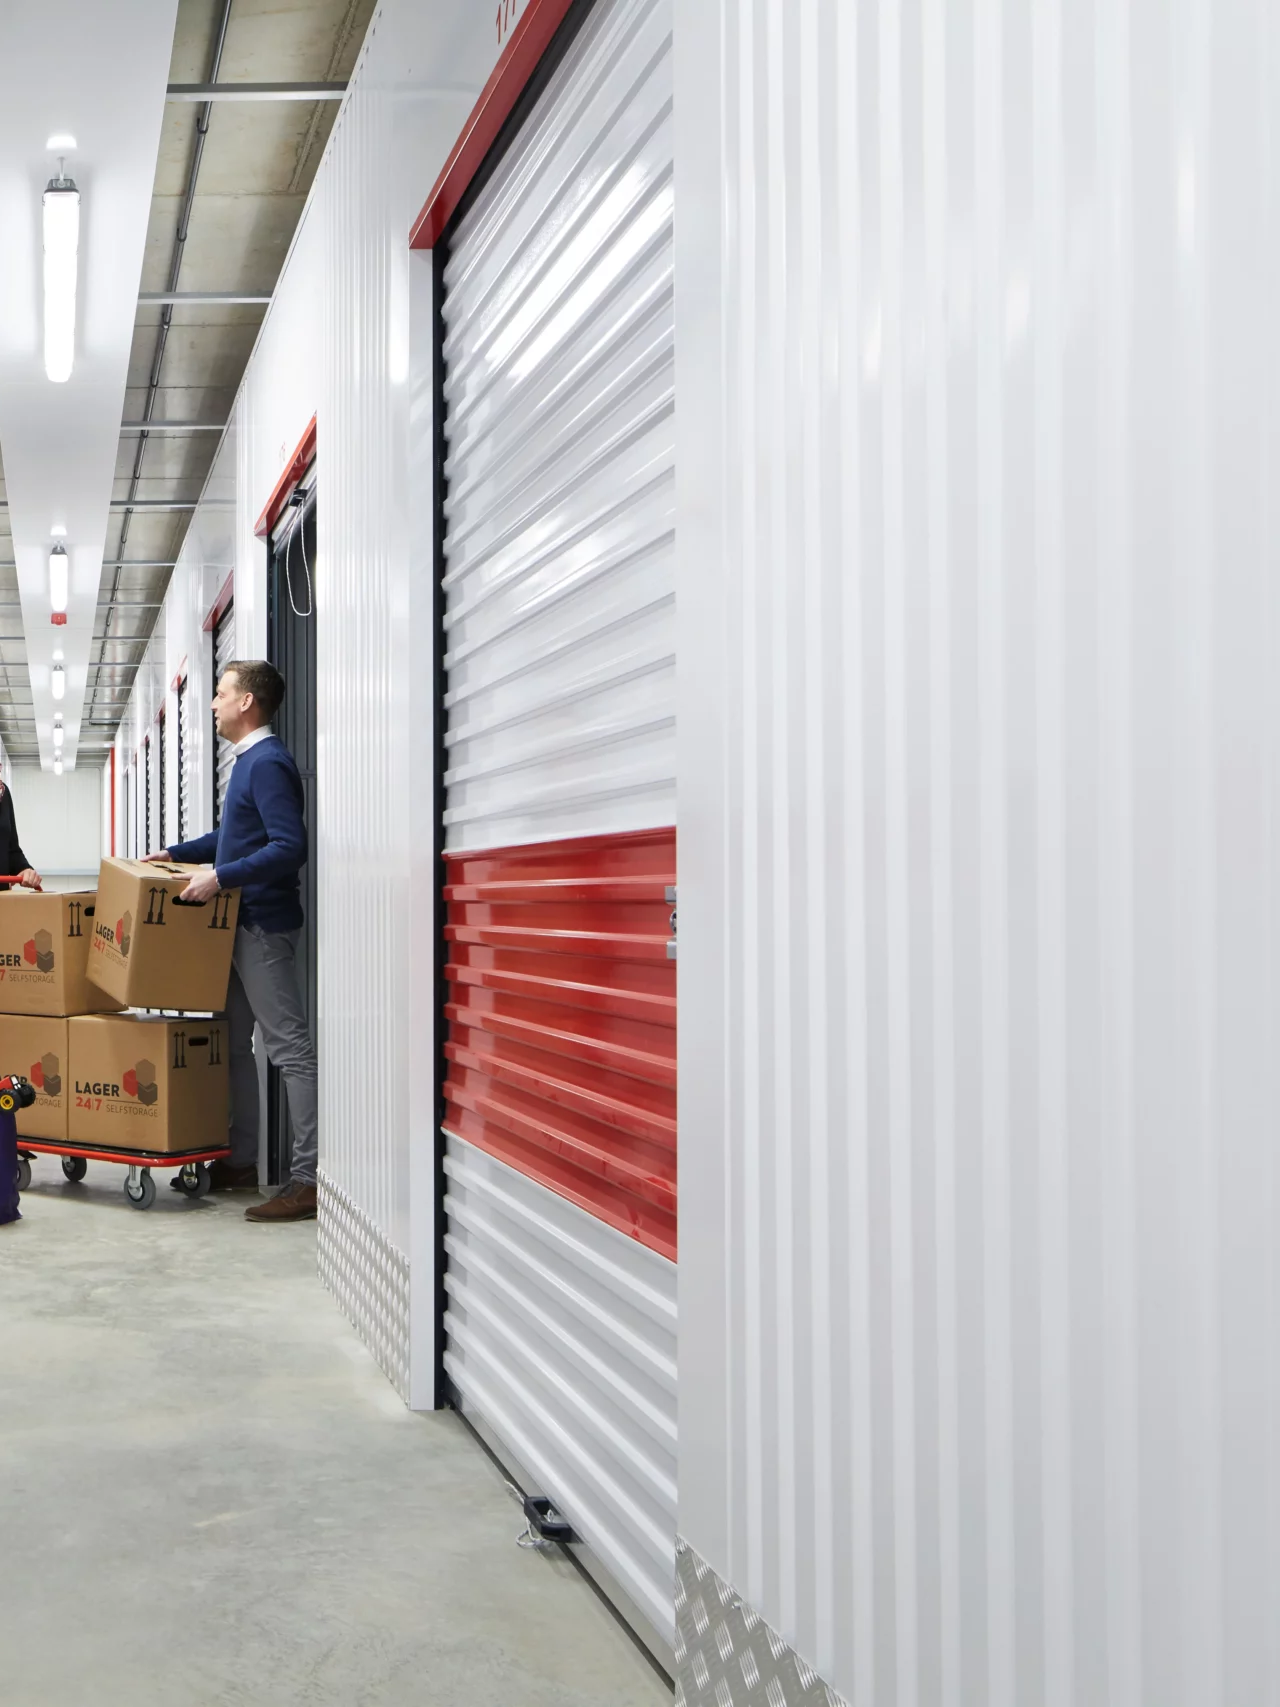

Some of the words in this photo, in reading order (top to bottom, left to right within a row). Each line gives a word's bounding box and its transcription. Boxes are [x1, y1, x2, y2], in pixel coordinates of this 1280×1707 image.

[95, 921, 115, 943] LAGER
[8, 973, 56, 984] SELFSTORAGE
[75, 1080, 120, 1098] LAGER
[105, 1104, 159, 1118] SELFSTORAGE
